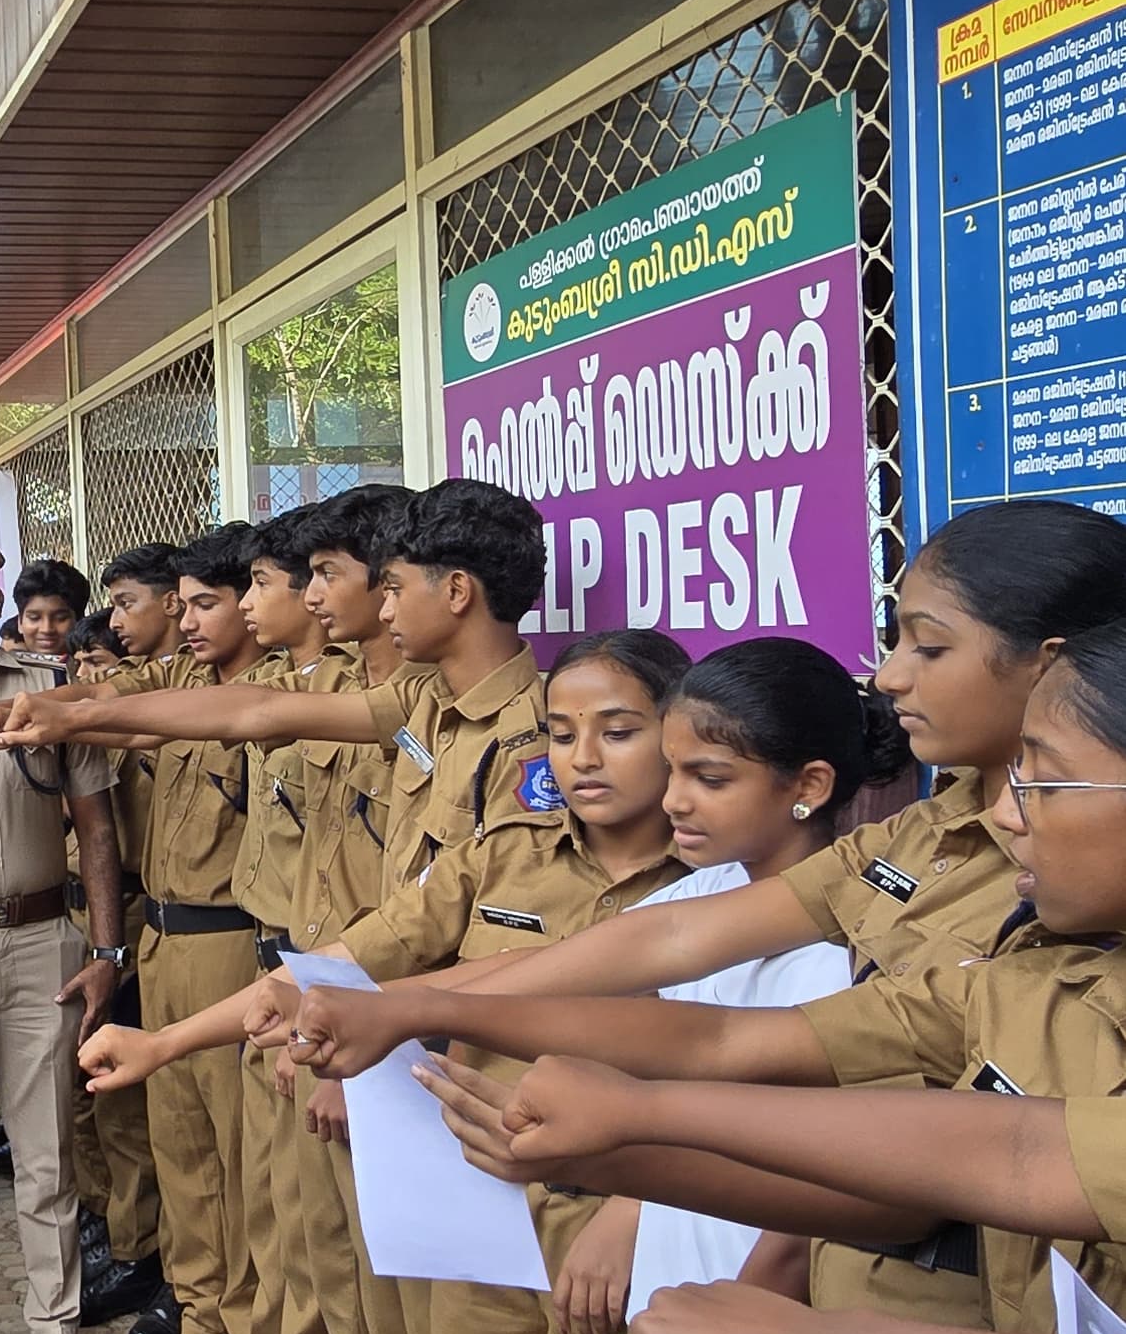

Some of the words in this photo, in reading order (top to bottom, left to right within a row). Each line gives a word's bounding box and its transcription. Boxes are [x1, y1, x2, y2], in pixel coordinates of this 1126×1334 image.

[951, 17, 982, 51] ക്രമ
[945, 34, 990, 75] നമ്പർ
[1004, 60, 1034, 84] ജനന
[962, 82, 972, 99] 1.
[1006, 131, 1035, 155] മരണ
[519, 234, 595, 289] പള്ളിക്കൽ
[599, 155, 764, 260] ഗ്രാമപഞ്ചായത്ത്
[1008, 200, 1038, 222] ജനന
[964, 215, 977, 233] 2.
[506, 259, 622, 342] കുടുംബശ്രീ
[629, 186, 799, 294] സി.ഡി.എസ്
[1010, 318, 1043, 338] കേരള
[969, 394, 981, 411] 3.
[1012, 387, 1040, 405] മരണ
[1064, 427, 1096, 446] കേരള
[517, 517, 603, 634] LP
[624, 484, 809, 631] DESK
